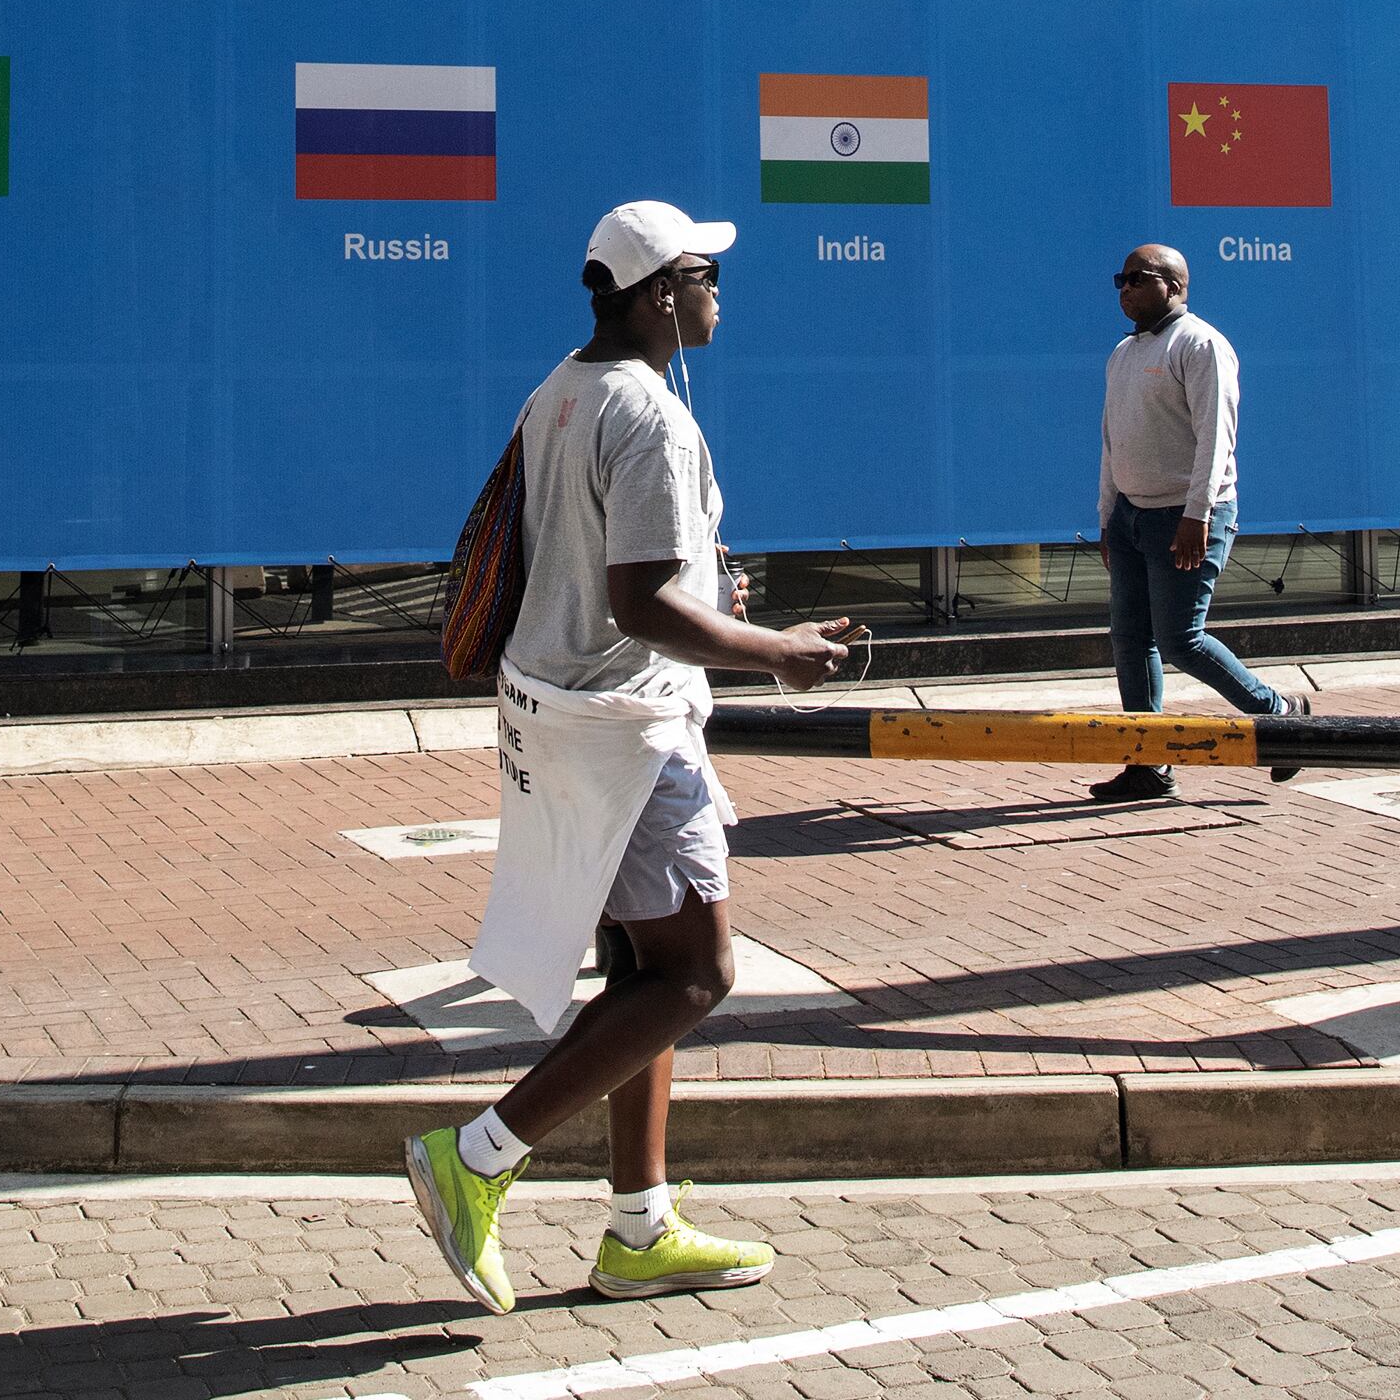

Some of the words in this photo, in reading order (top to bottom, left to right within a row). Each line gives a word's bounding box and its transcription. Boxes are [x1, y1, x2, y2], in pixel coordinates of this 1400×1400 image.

[344, 233, 450, 260] Russia
[817, 235, 886, 261] India
[1218, 236, 1292, 262] China
[502, 715, 524, 753] THE
